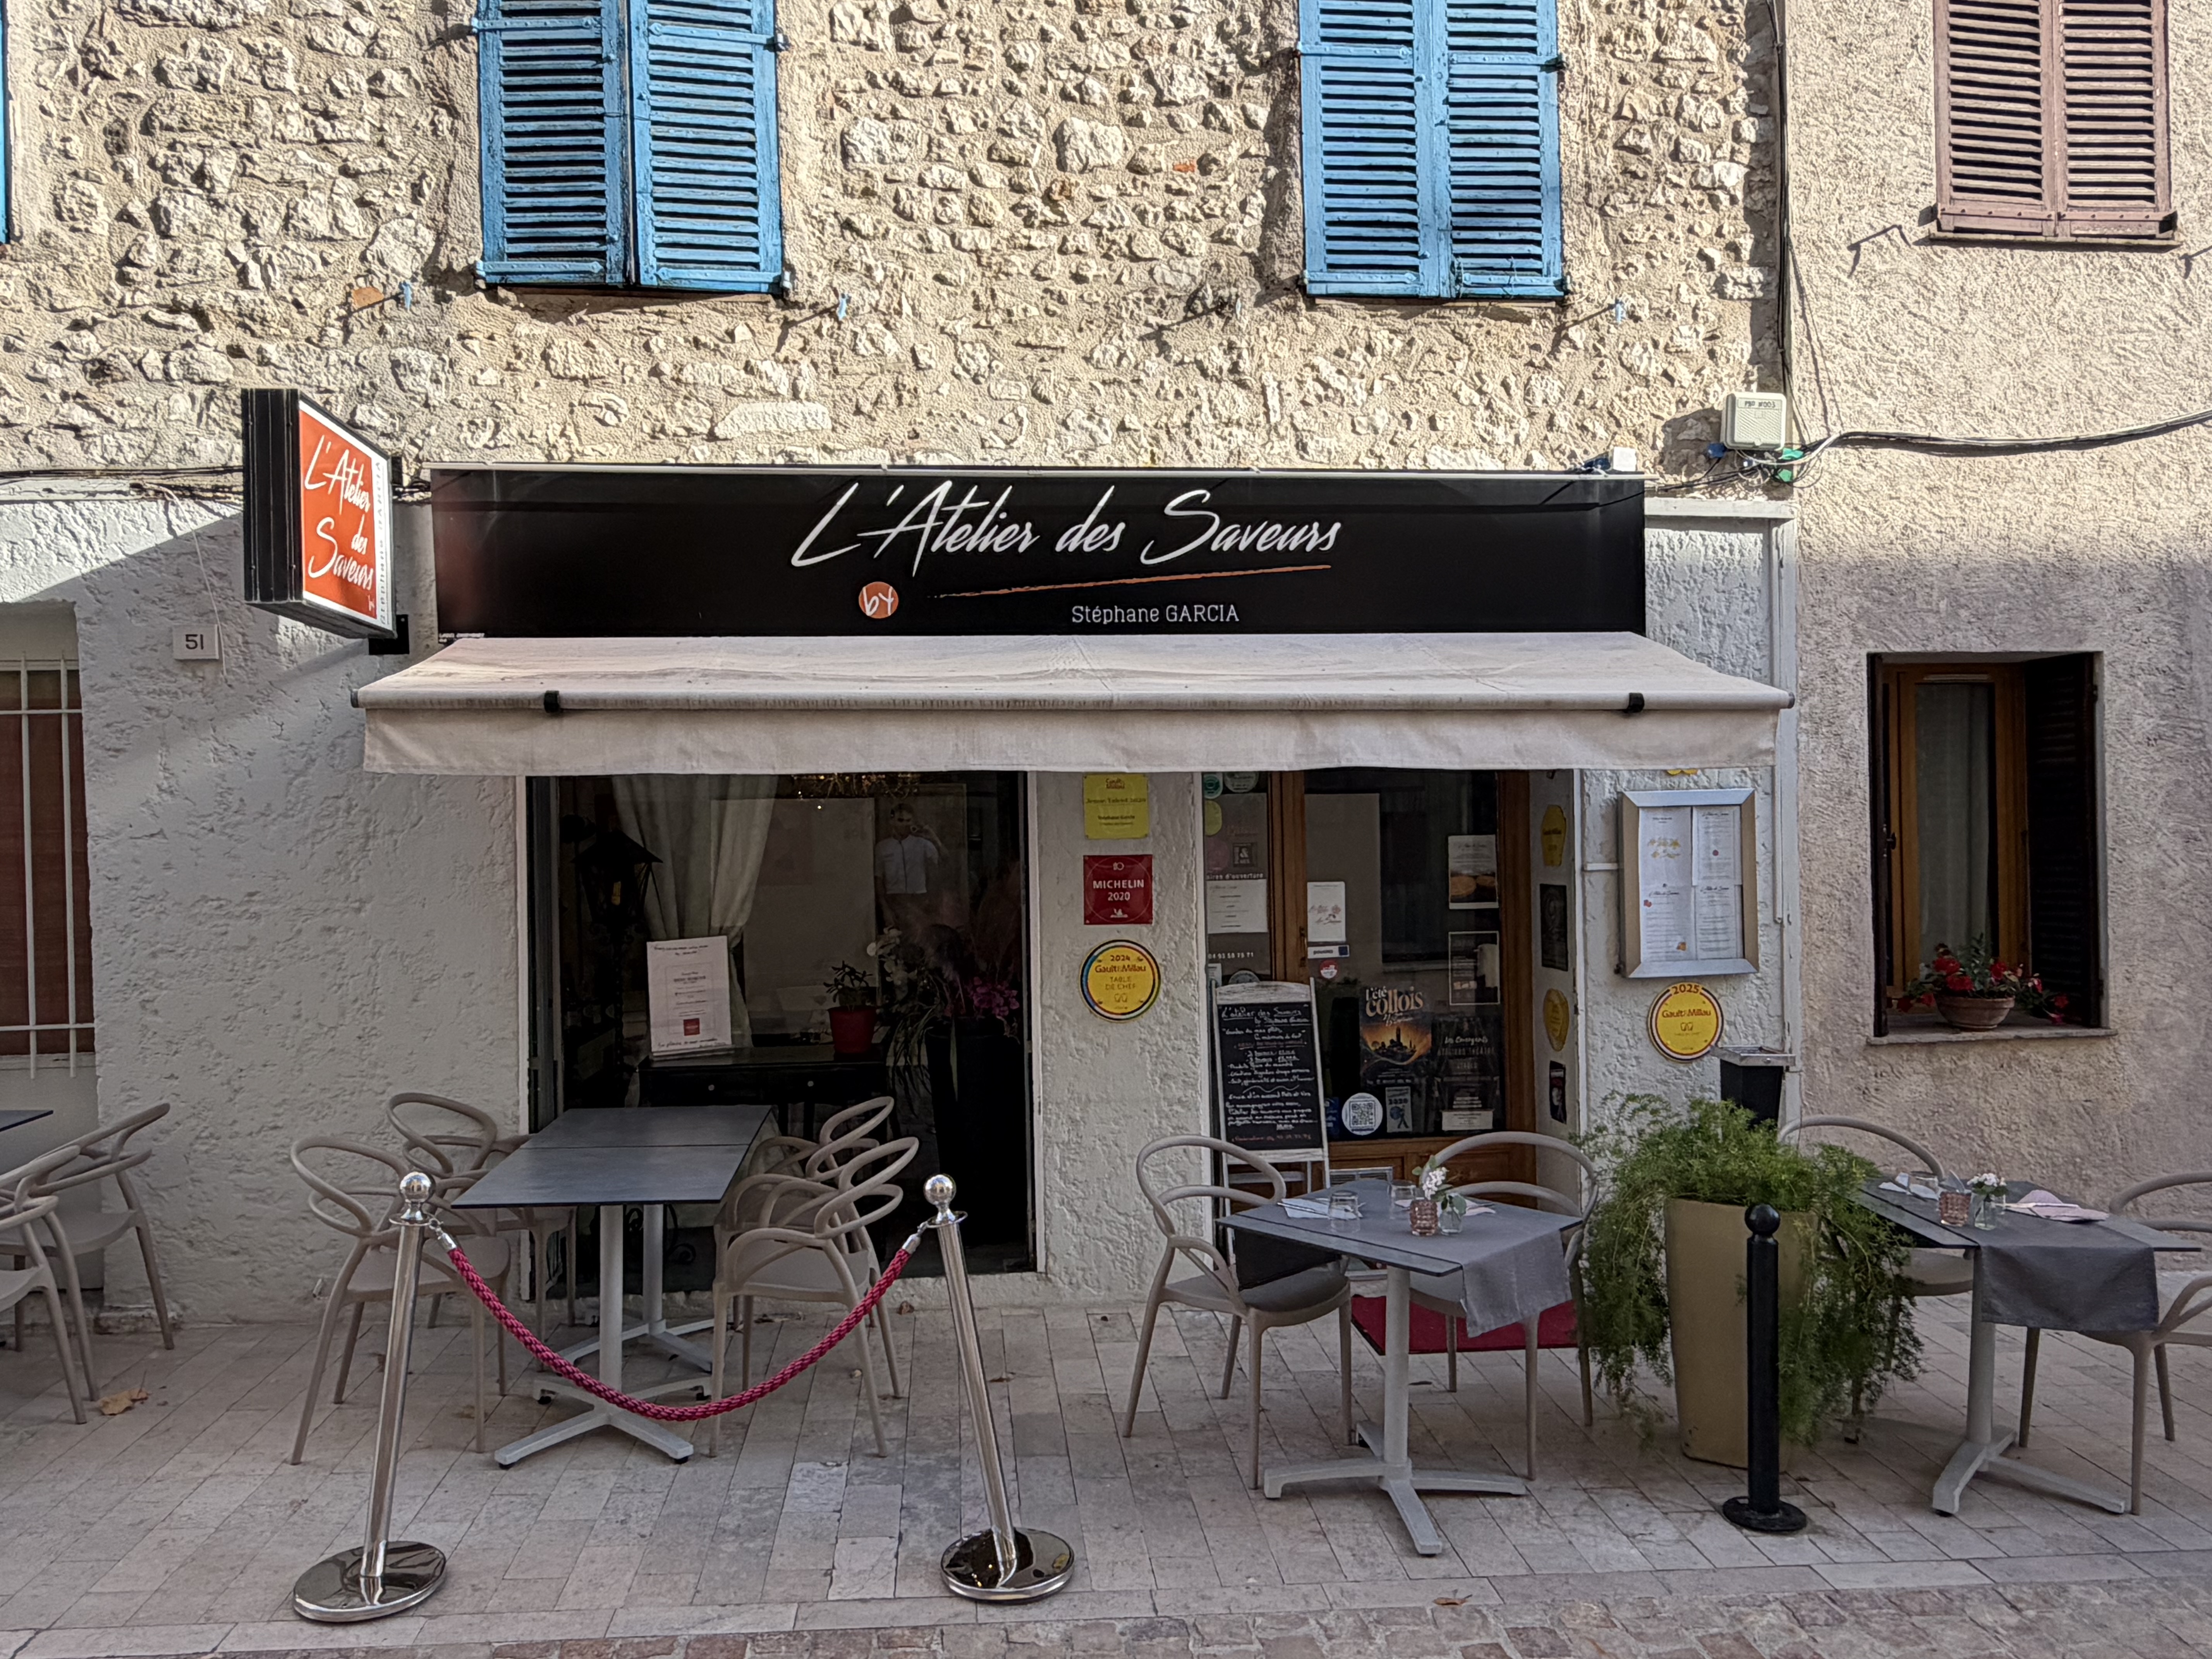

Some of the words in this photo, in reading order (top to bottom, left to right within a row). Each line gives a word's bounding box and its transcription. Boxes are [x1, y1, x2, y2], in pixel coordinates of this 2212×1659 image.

[305, 435, 370, 515] L'Atelier
[351, 514, 367, 555] des
[791, 480, 1040, 577] L'Atelier
[1055, 485, 1125, 552] des
[1140, 489, 1341, 565] Saveurs
[308, 517, 373, 590] Saveurs
[1072, 605, 1159, 625] Stéphane
[1166, 605, 1240, 622] GARCIA
[185, 633, 204, 650] 51
[1092, 879, 1144, 889] MICHELIN
[1108, 892, 1131, 902] 2020
[1365, 986, 1424, 1017] collois
[1671, 984, 1700, 994] 2025
